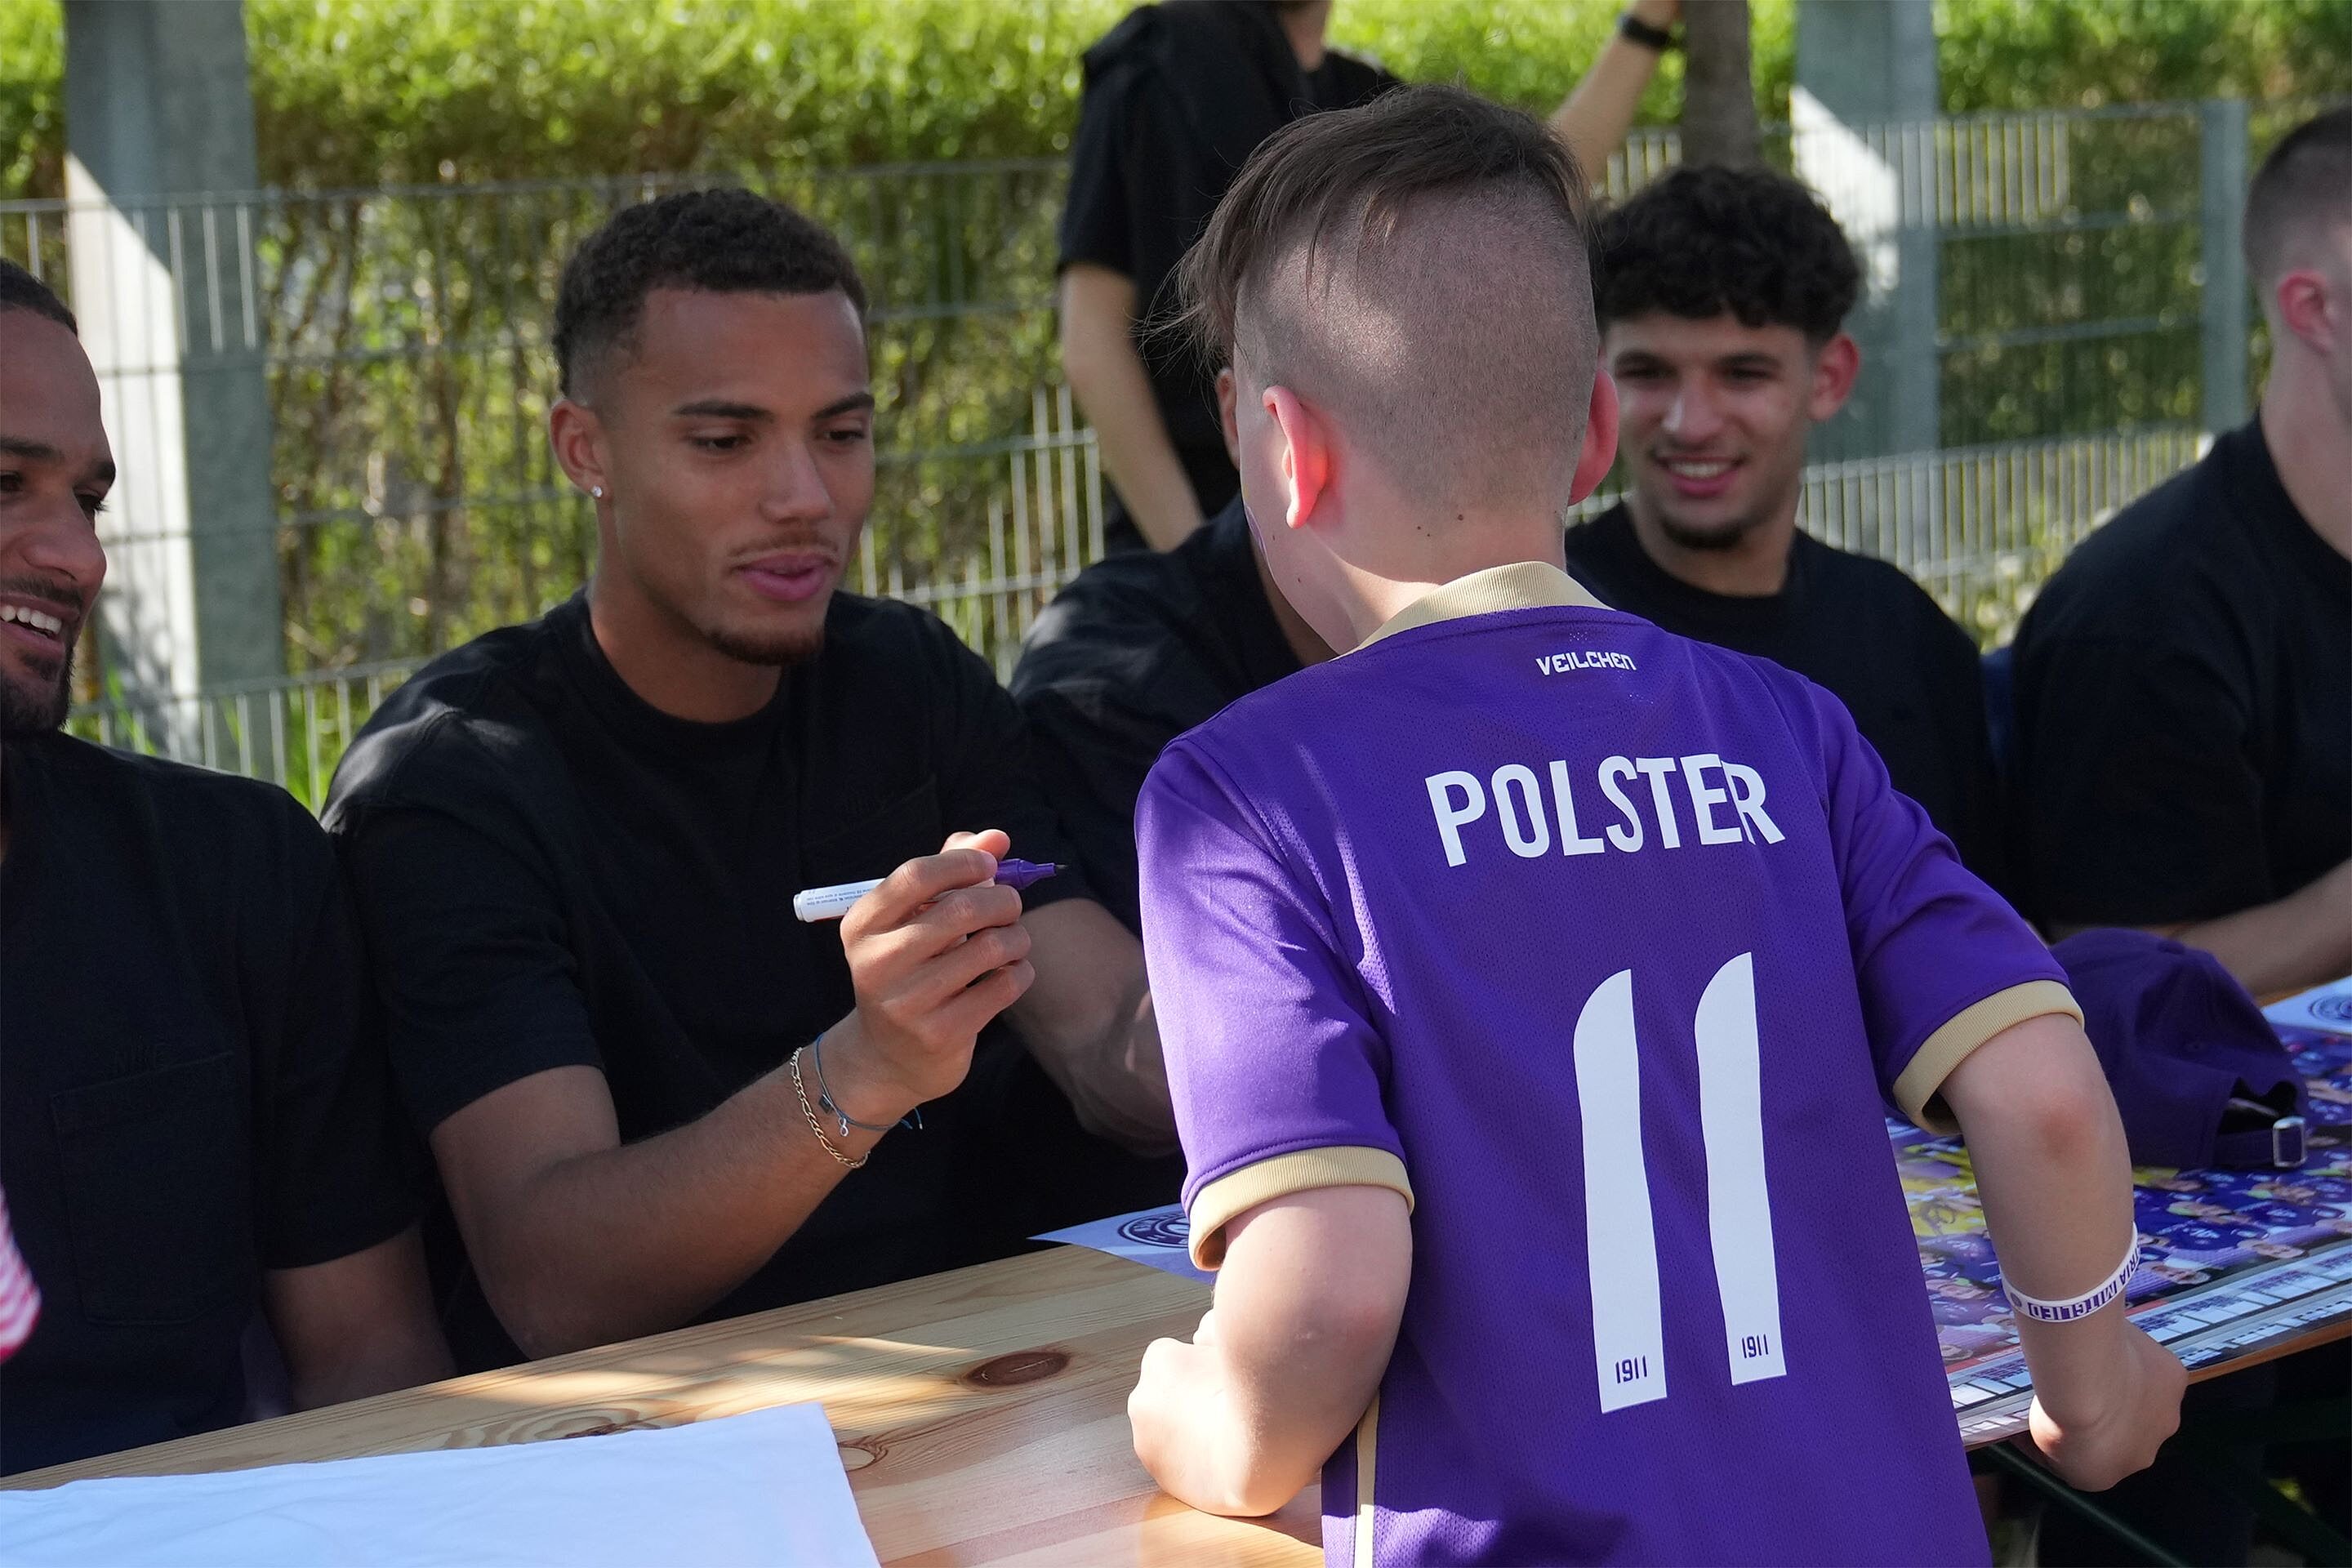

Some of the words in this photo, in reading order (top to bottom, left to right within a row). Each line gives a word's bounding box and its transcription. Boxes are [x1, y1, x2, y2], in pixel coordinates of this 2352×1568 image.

[1535, 652, 1637, 675] VEILCHEN
[1424, 753, 1786, 867] POLSTER
[1573, 951, 1787, 1414] 11
[2119, 1245, 2139, 1285] TRIA
[2029, 1280, 2118, 1320] MITGLIED
[1741, 1334, 1769, 1359] 1911
[1615, 1355, 1648, 1384] 1911
